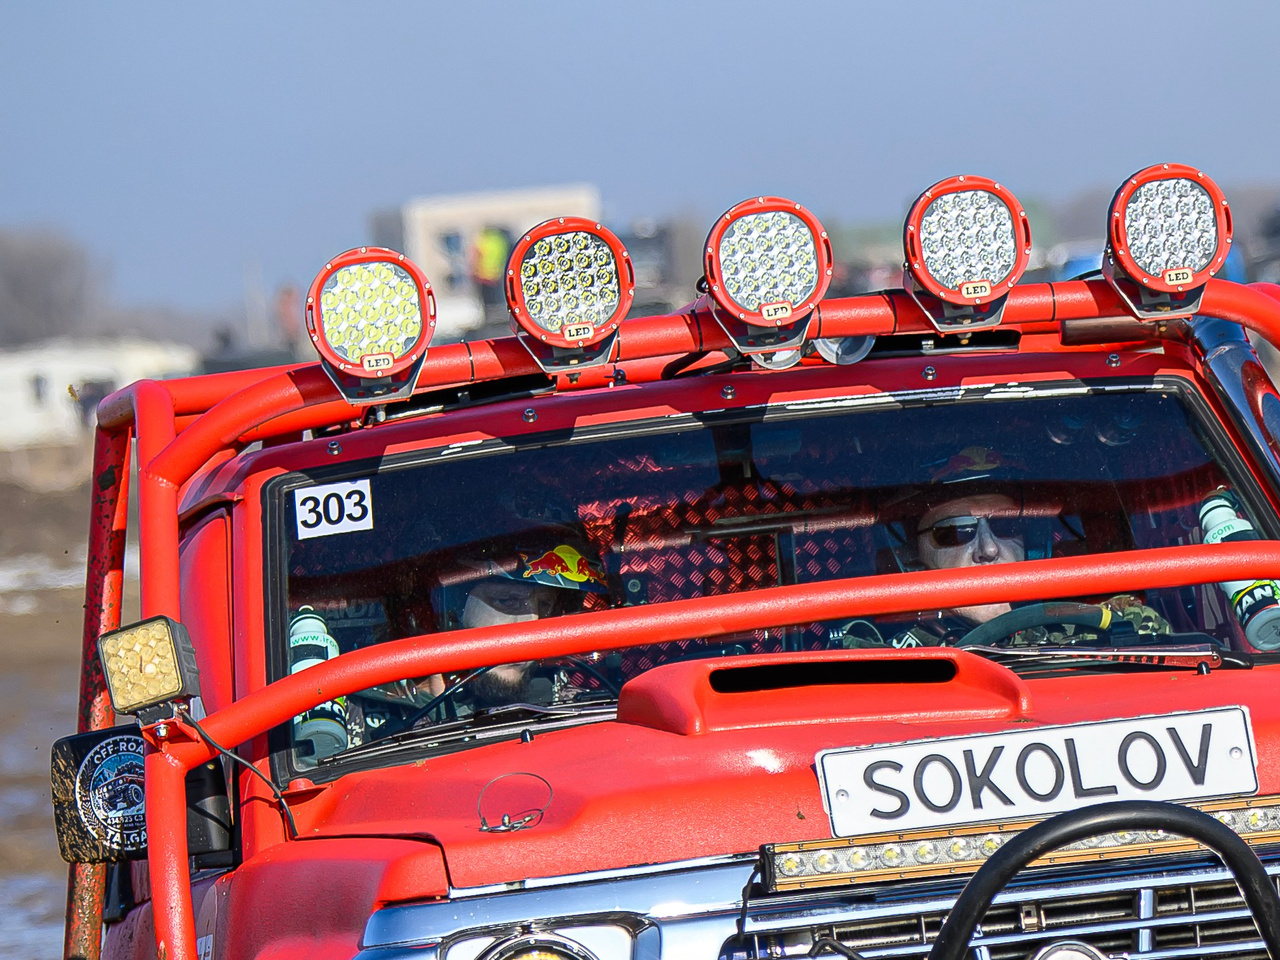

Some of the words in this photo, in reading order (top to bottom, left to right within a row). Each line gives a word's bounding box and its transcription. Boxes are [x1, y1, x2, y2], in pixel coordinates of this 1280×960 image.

[1168, 271, 1190, 284] LED
[965, 283, 988, 296] LED
[765, 305, 788, 318] LED
[568, 326, 590, 339] LED
[366, 357, 391, 370] LED
[300, 489, 368, 529] 303
[93, 741, 144, 764] OFF-ROA
[862, 722, 1213, 820] SOKOLOV
[106, 828, 147, 845] TALGA
